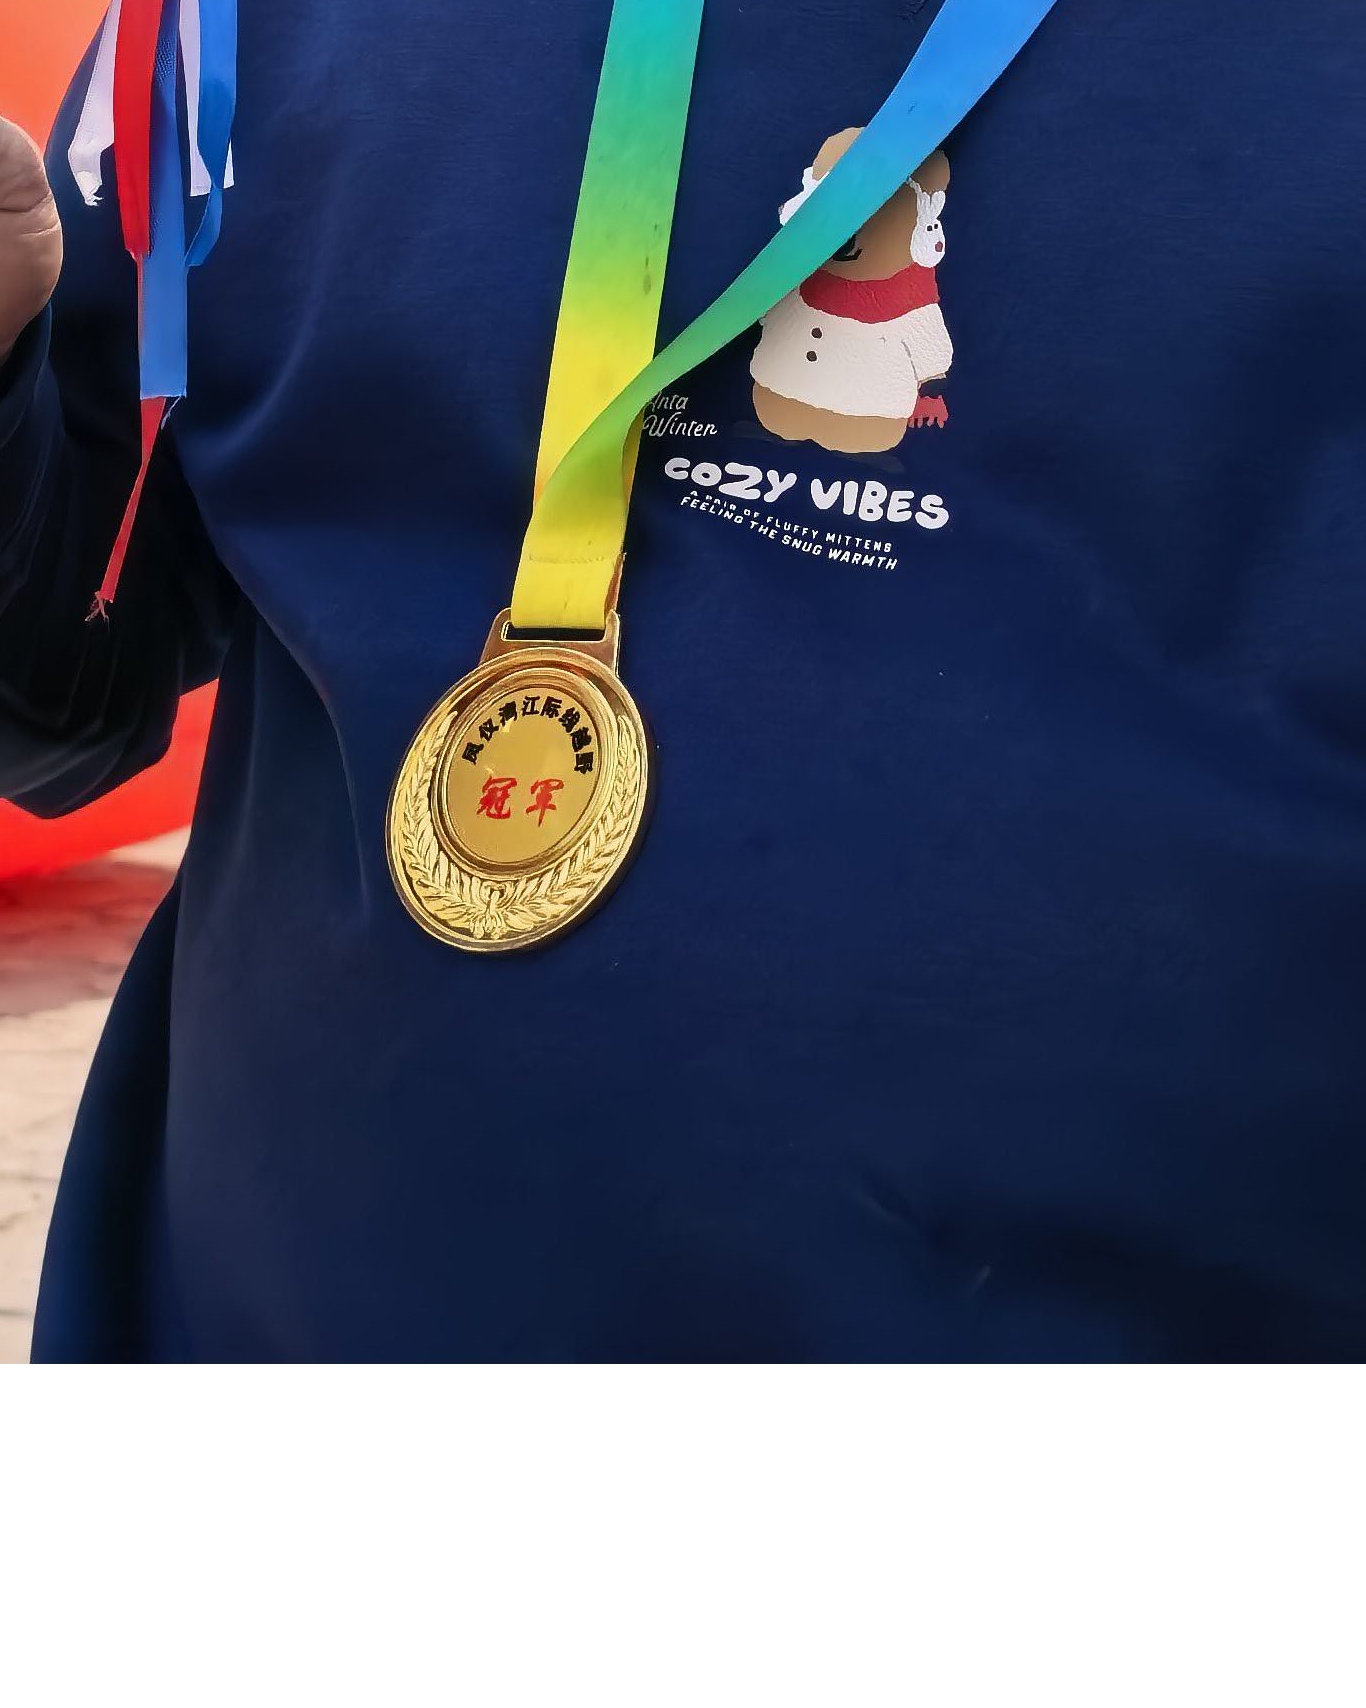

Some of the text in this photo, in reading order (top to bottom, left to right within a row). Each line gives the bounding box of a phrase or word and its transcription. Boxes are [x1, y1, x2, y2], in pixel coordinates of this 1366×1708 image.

[643, 411, 718, 438] Winter
[664, 457, 951, 530] COZY VIBES
[680, 496, 899, 571] FEELING THE SNUG WARMTH
[743, 509, 761, 519] OF
[766, 515, 819, 540] FLUFFY
[825, 531, 893, 554] MITTENS
